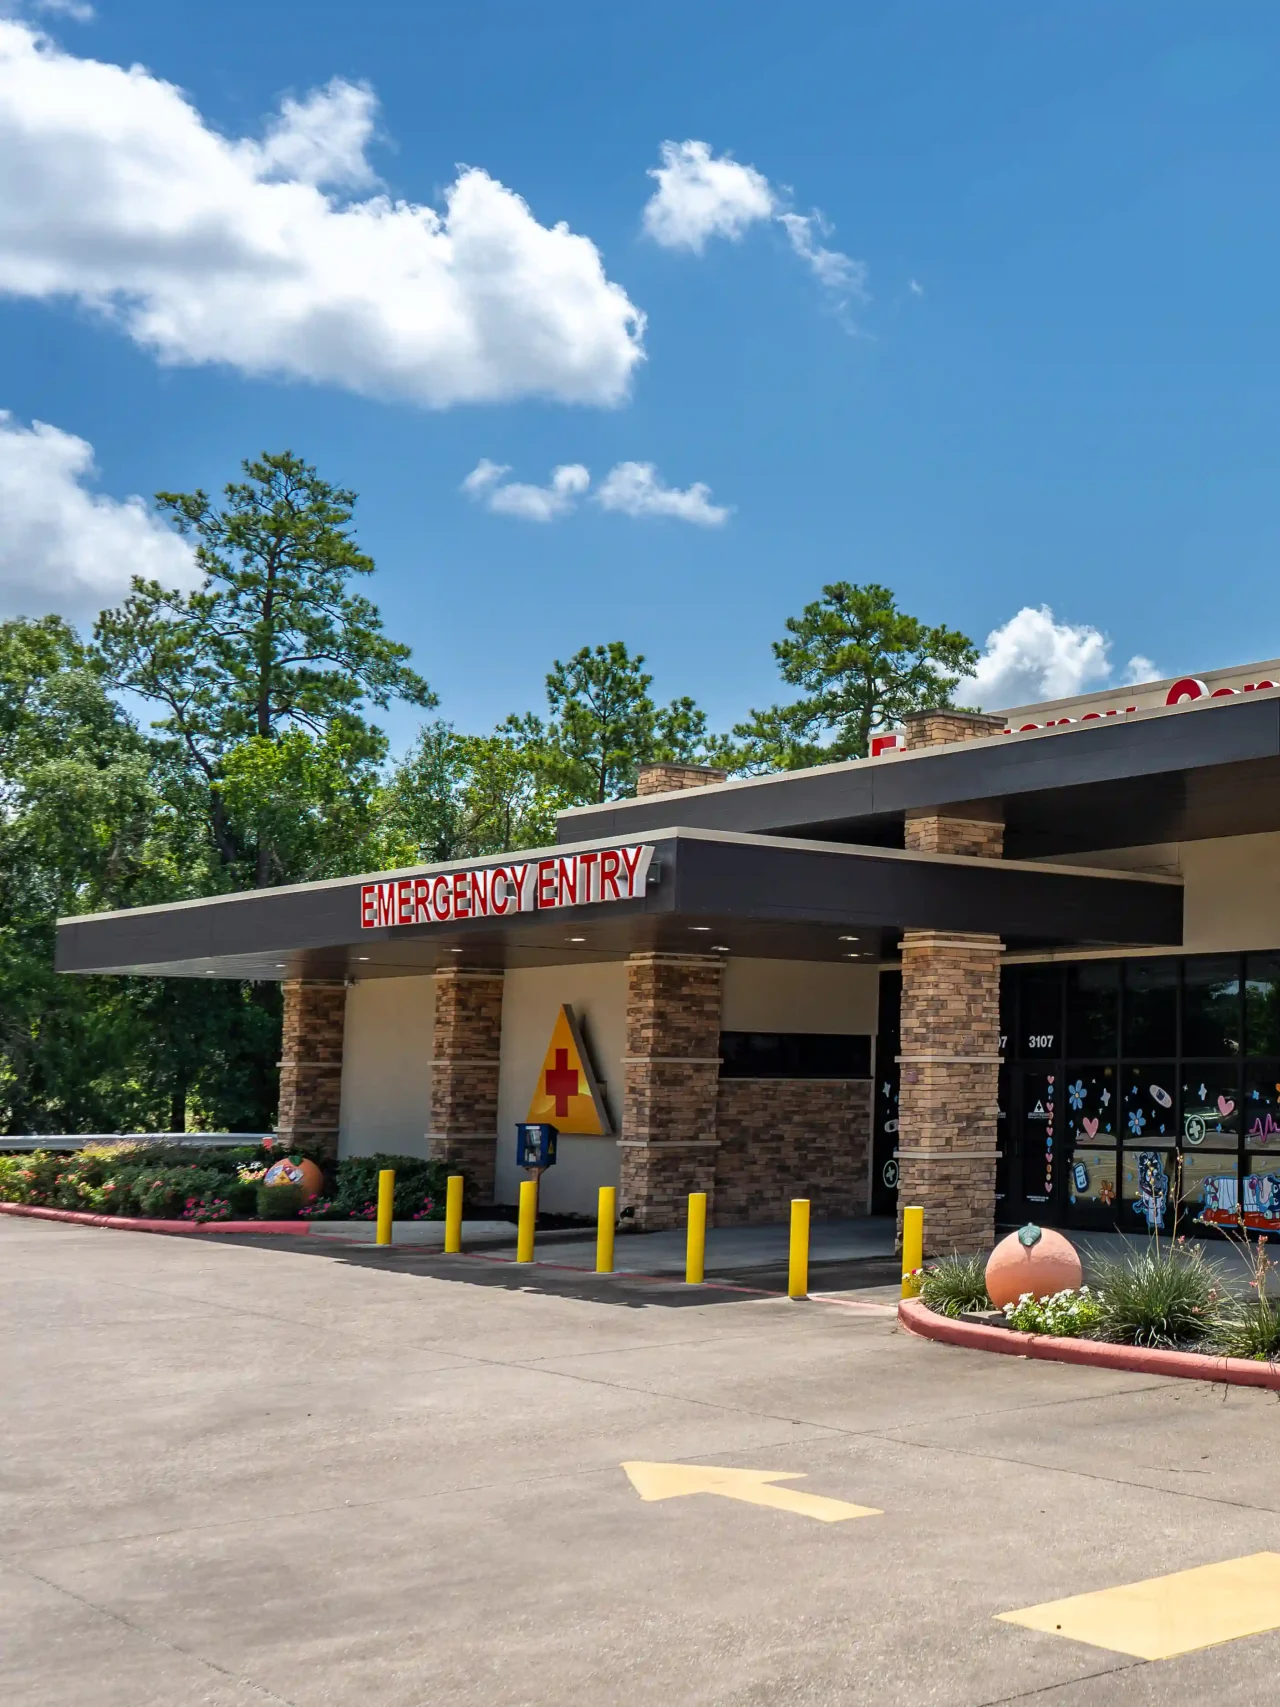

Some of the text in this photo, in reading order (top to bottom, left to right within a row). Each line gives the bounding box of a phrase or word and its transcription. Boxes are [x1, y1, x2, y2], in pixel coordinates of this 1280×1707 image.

[361, 845, 646, 928] EMERGENCY ENTRY
[1028, 1035, 1054, 1048] 3107
